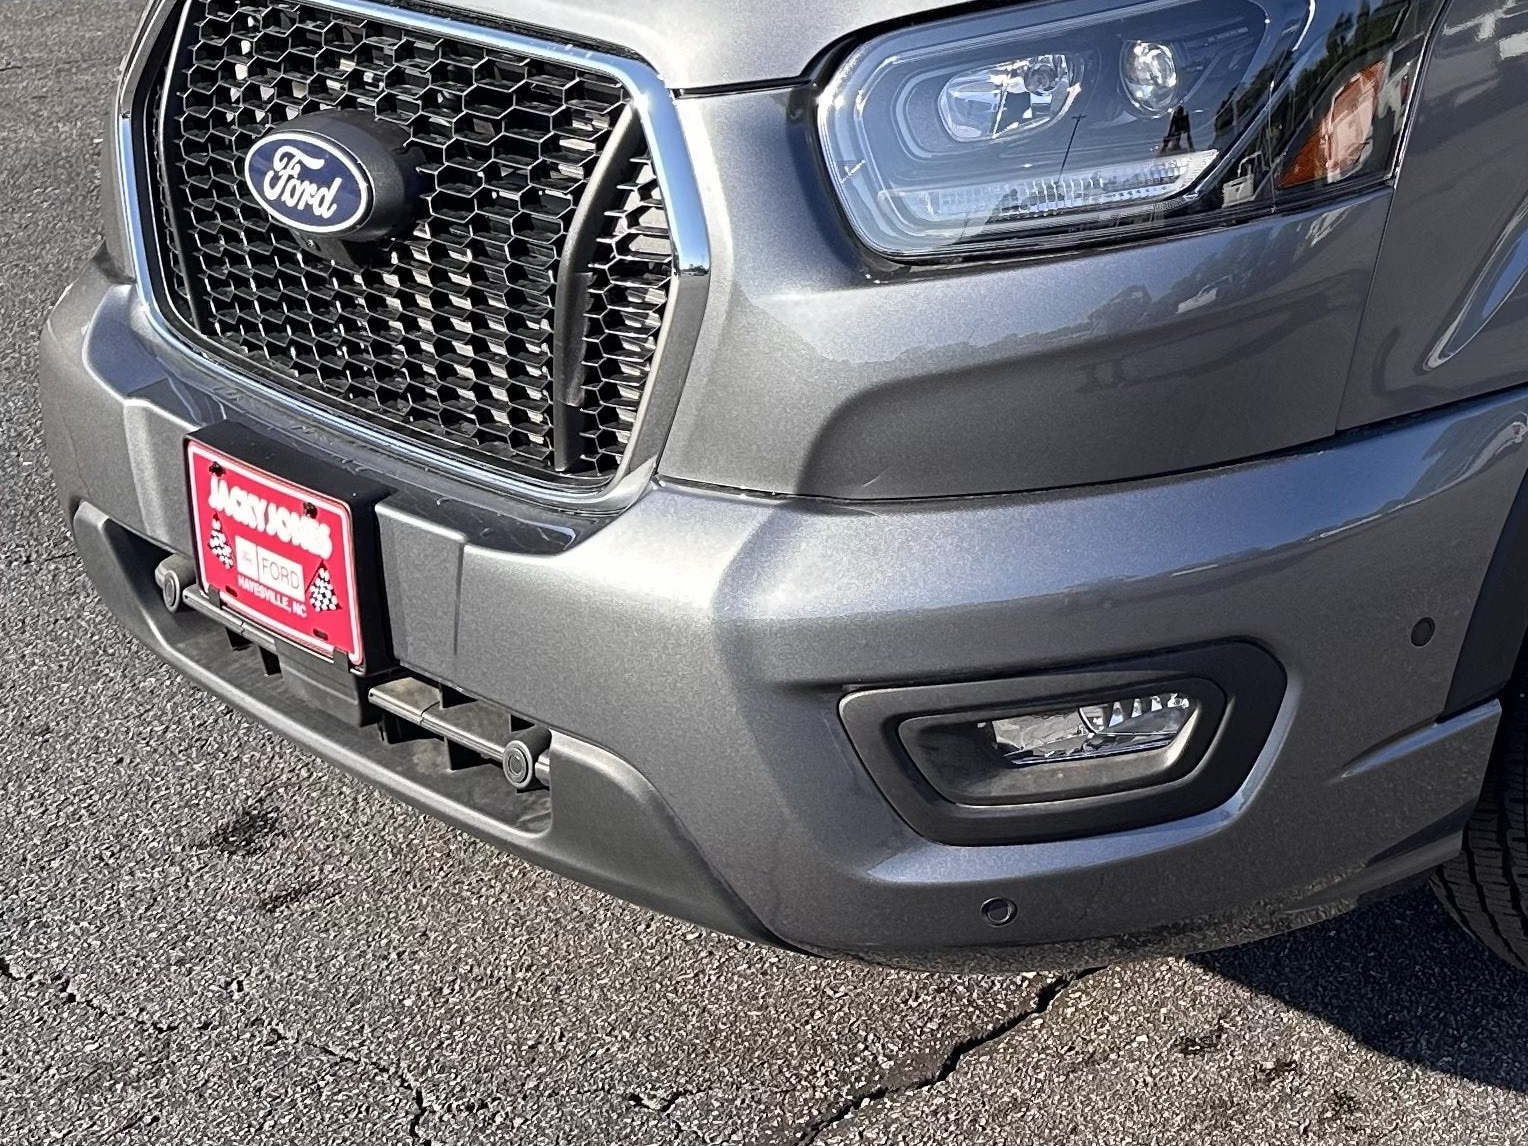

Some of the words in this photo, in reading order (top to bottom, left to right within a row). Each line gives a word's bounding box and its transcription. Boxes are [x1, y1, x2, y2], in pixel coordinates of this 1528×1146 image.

[263, 145, 342, 219] Ford
[261, 557, 300, 590] FORD
[292, 601, 308, 618] NC
